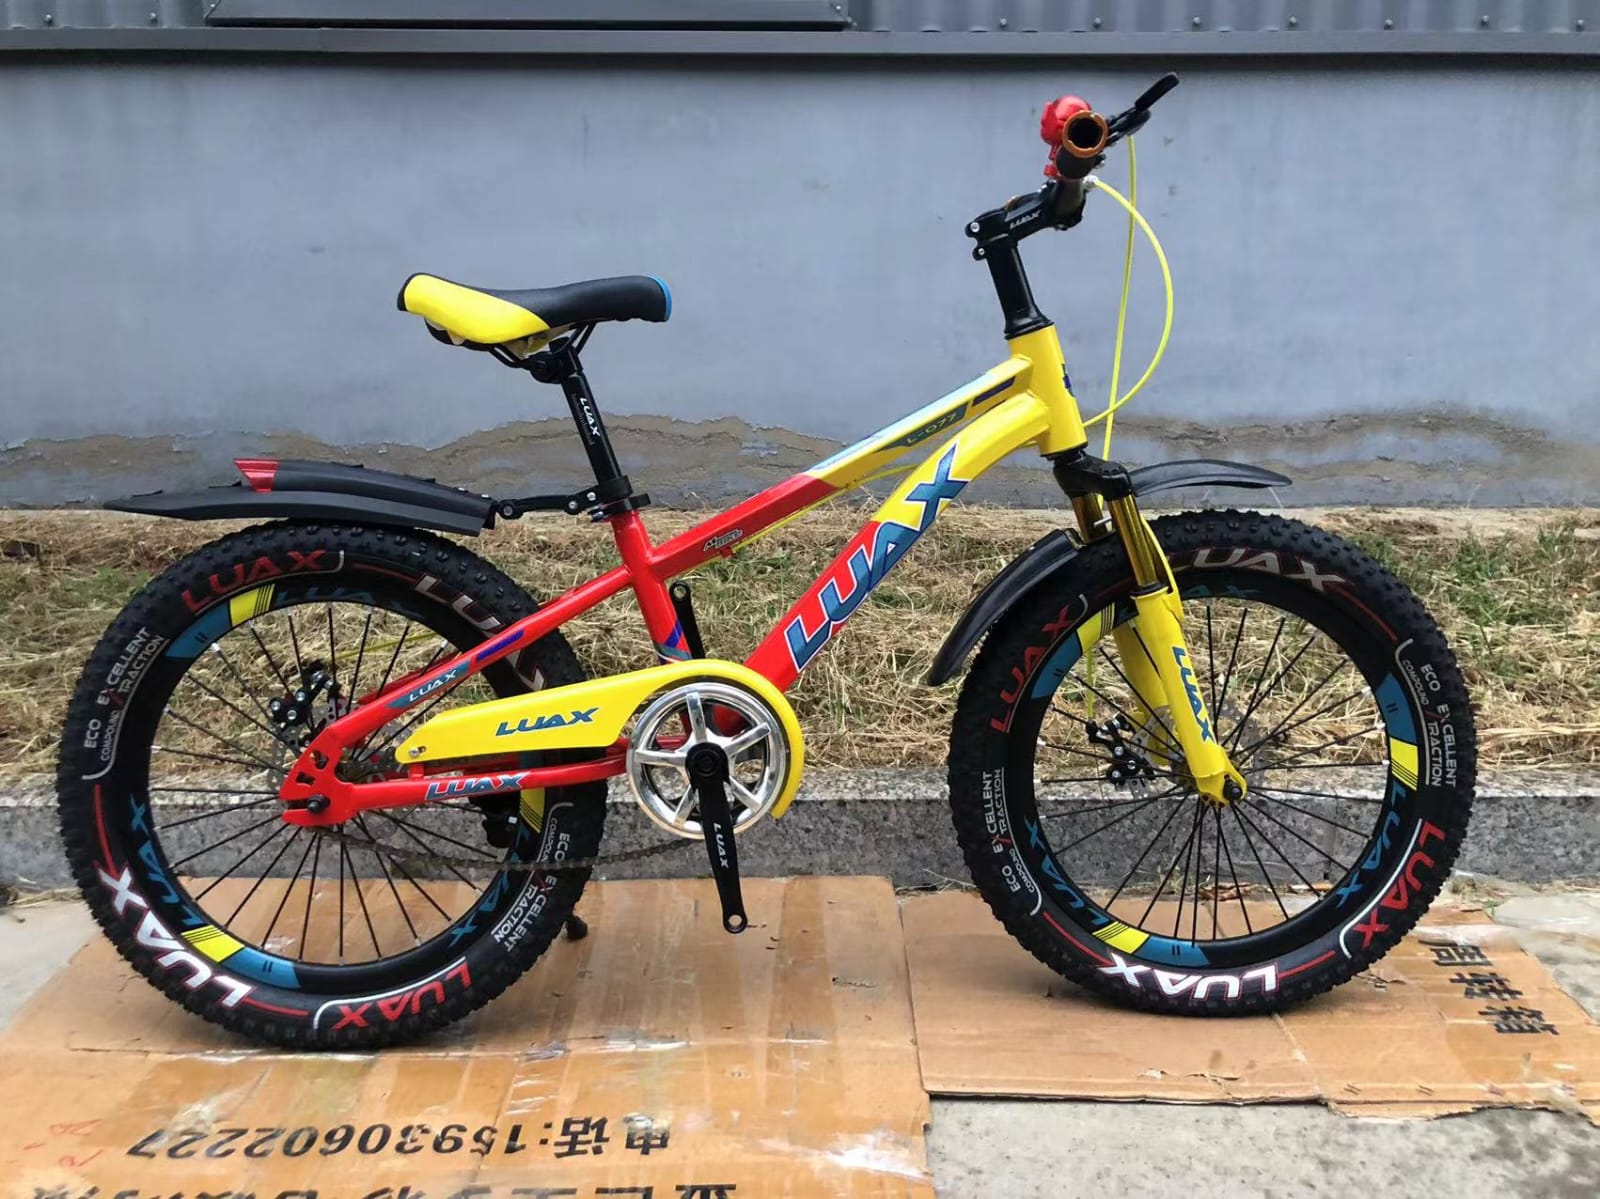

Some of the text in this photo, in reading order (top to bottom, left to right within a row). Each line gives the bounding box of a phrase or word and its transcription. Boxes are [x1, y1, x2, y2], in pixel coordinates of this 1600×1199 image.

[580, 397, 600, 436] LUAX
[181, 549, 326, 612] LUAX
[784, 439, 971, 674] LUAX
[101, 635, 165, 761] COMPOUND TRACTION
[409, 670, 457, 702] LUAX
[991, 604, 1073, 733] LUAX
[1172, 646, 1217, 744] LUAX
[1420, 664, 1441, 692] ECO
[83, 718, 101, 749] ECO
[495, 707, 599, 737] LUAX
[1402, 659, 1442, 786] COMPOUND TRACTION
[425, 771, 531, 800] LUAX
[994, 769, 1007, 834] TRACTION
[130, 793, 206, 926] LUAX
[554, 832, 571, 862] ECO
[713, 823, 729, 869] LUAX
[1024, 815, 1111, 927] LUAX
[1336, 781, 1408, 908] LUAX
[1002, 865, 1021, 893] ECO
[1355, 821, 1446, 949] LUAX
[96, 862, 252, 1008] LUAX
[493, 884, 538, 944] TRACTION
[332, 961, 473, 1030] LUAX
[1098, 952, 1278, 999] LUAX
